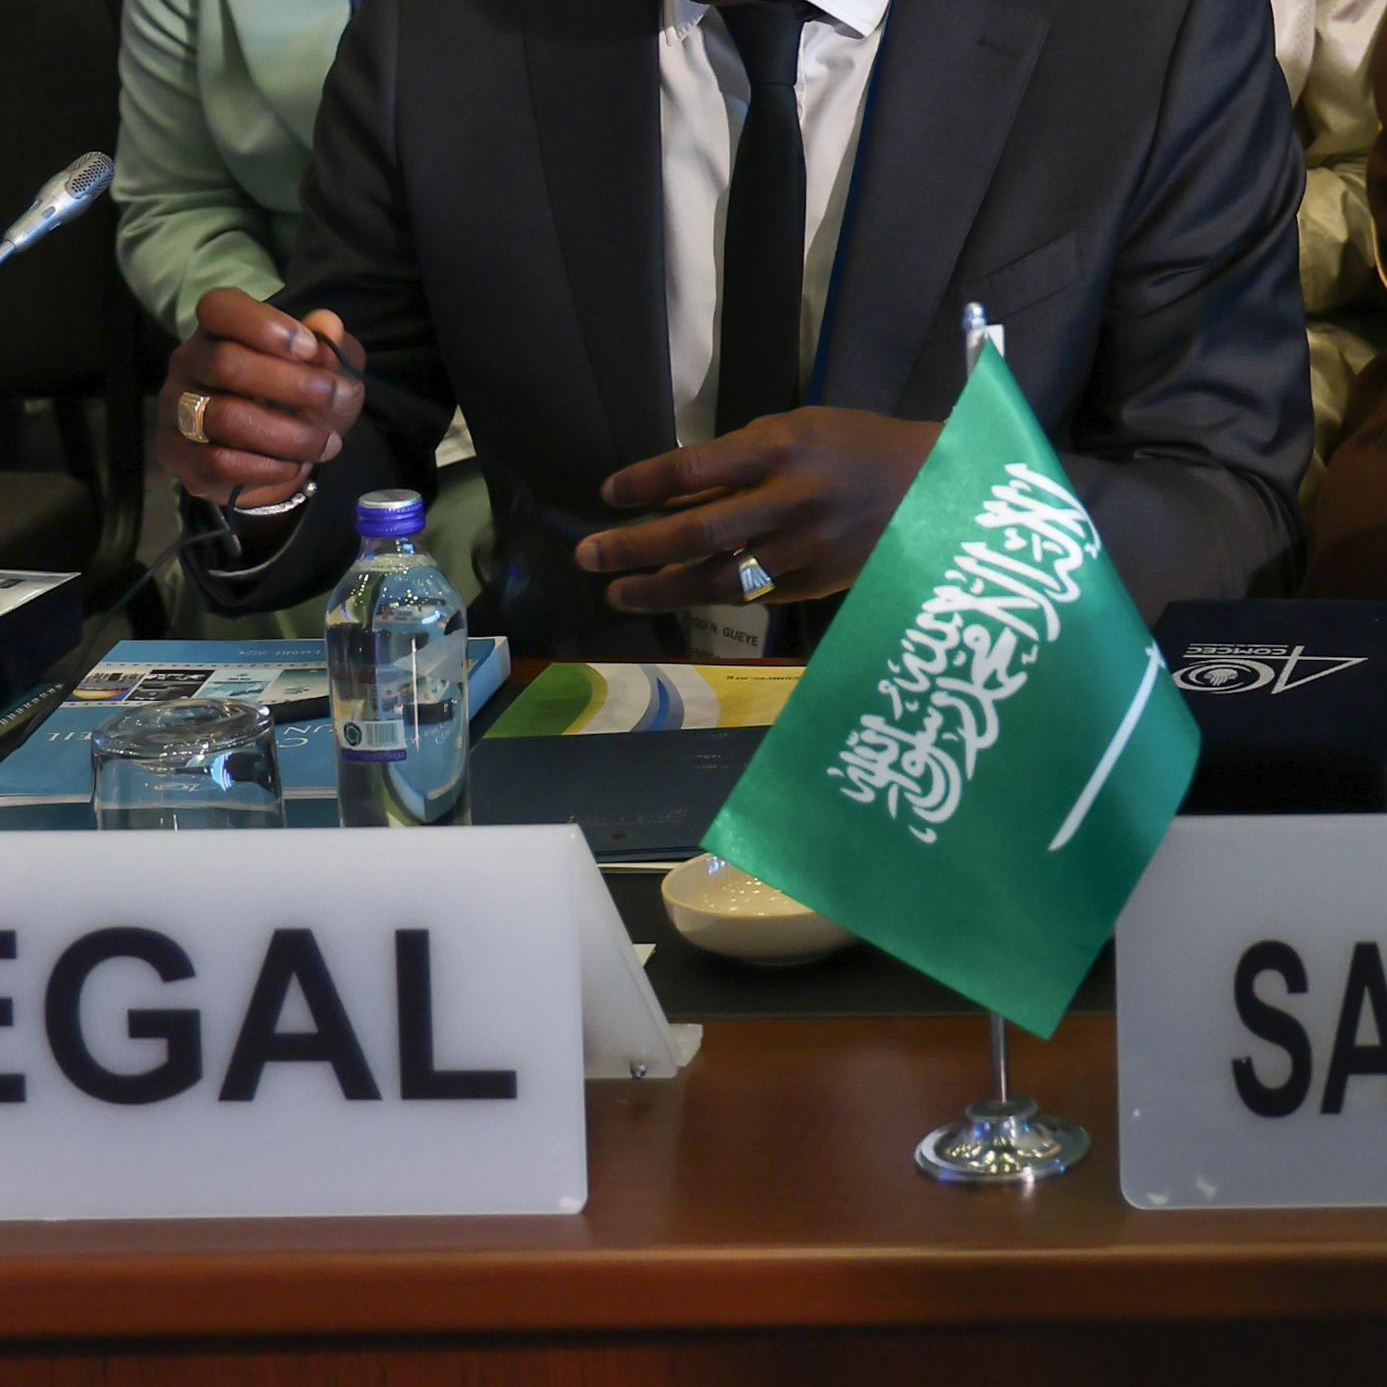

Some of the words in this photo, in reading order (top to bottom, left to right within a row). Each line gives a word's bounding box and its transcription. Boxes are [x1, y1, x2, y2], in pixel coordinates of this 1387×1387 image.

[722, 627, 759, 647] GUEYE
[1187, 647, 1288, 656] COMCEC
[0, 926, 518, 1105] GAL
